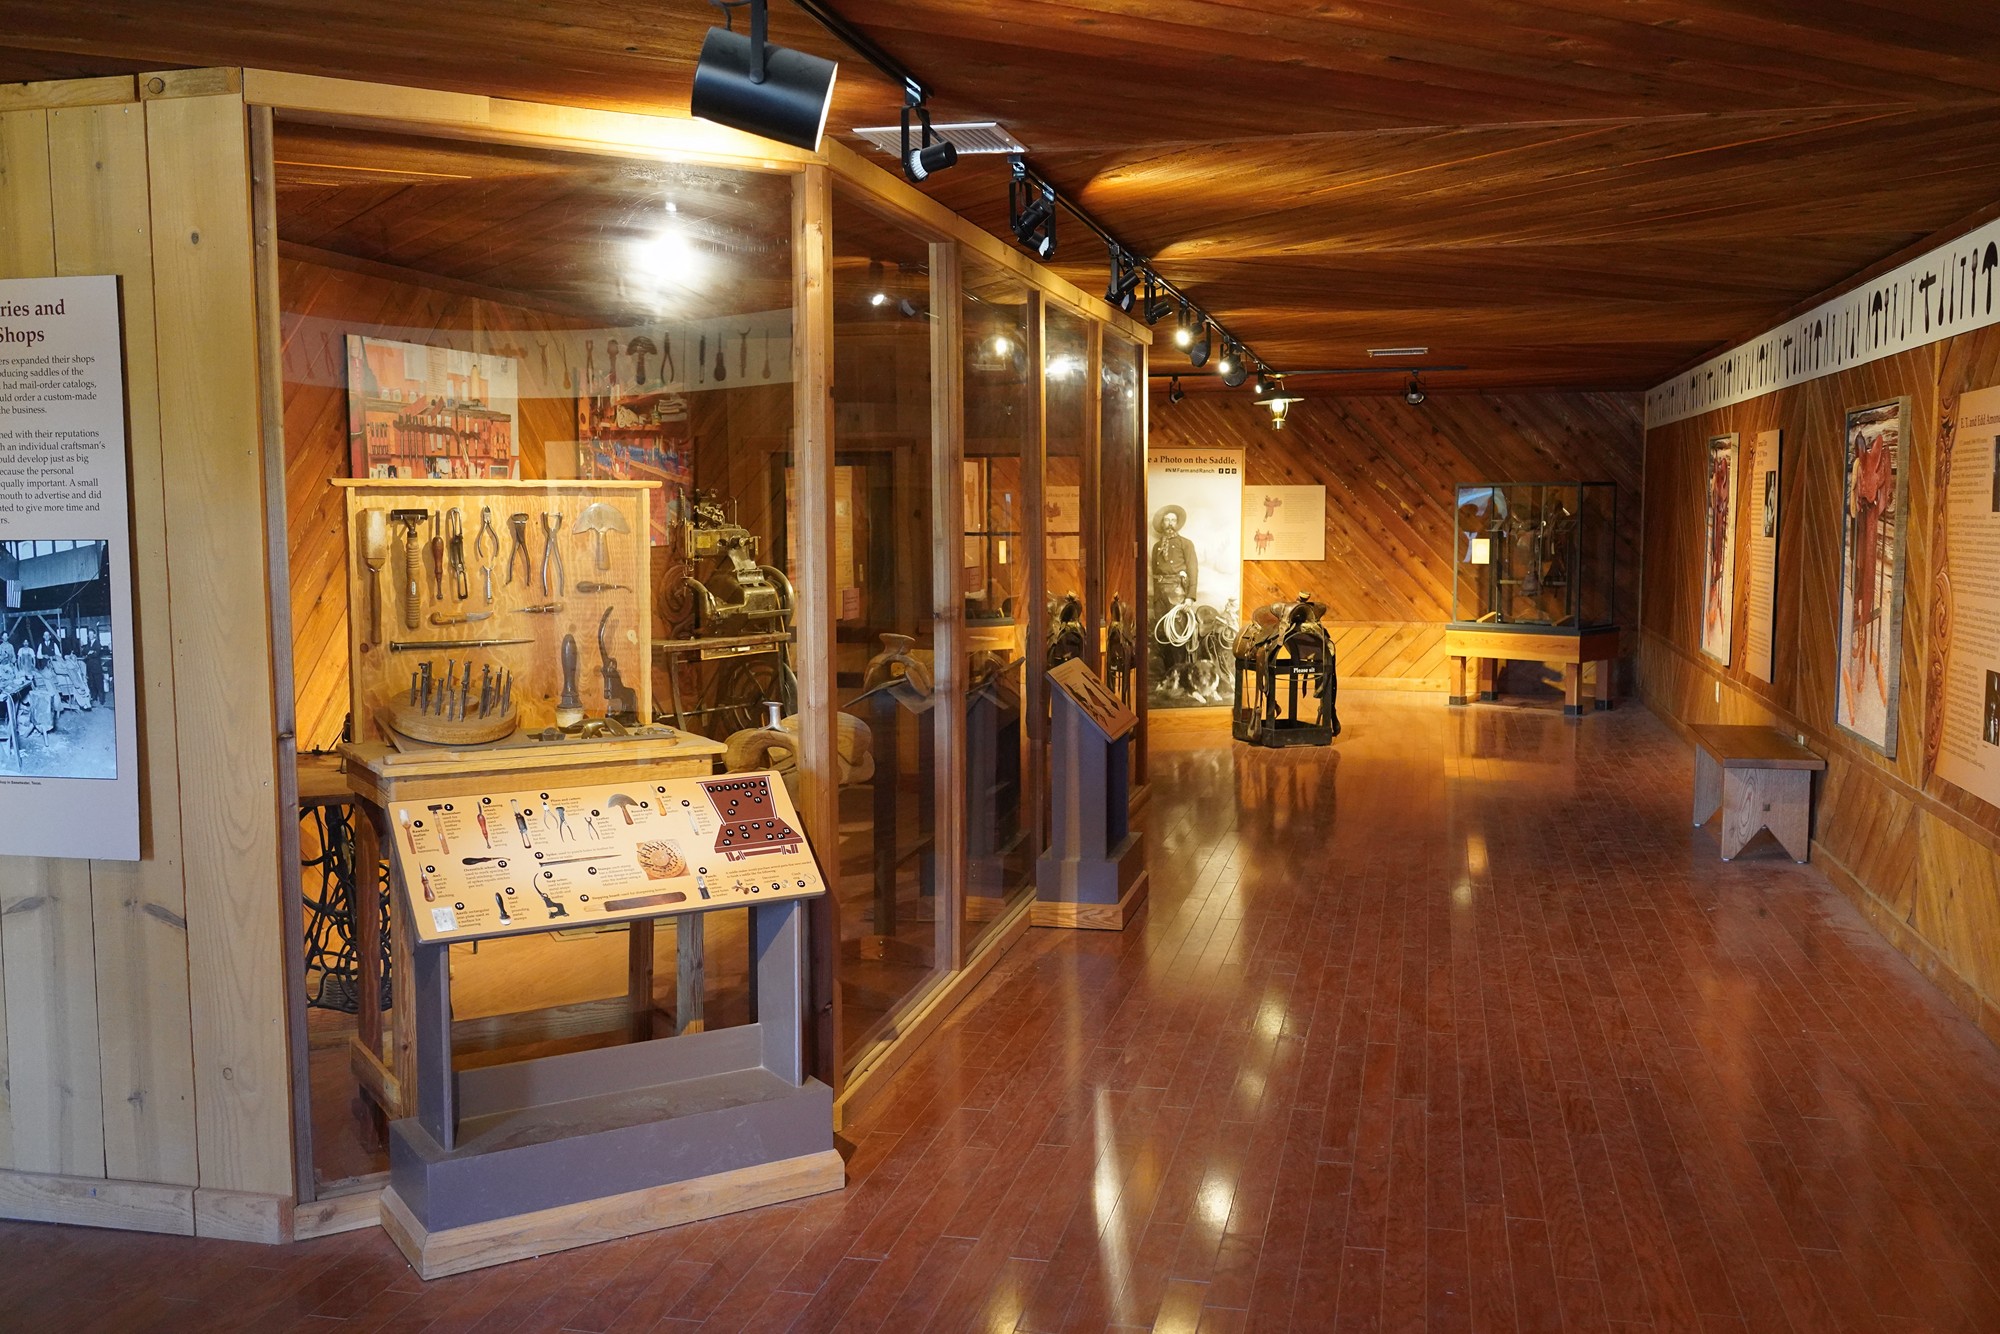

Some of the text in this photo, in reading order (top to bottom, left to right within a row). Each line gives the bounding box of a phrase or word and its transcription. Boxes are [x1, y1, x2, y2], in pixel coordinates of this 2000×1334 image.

[0, 299, 66, 316] ries and
[12, 356, 49, 367] expanded
[52, 355, 70, 364] their
[72, 355, 95, 365] shops
[0, 370, 28, 379] ducing
[30, 368, 60, 377] saddles
[72, 367, 84, 375] the
[3, 380, 97, 390] had mail-order catalogs,
[44, 392, 97, 401] custom-made
[12, 405, 47, 414] business.
[15, 430, 32, 438] with
[55, 429, 100, 440] reputations
[19, 442, 59, 450] individual
[18, 454, 48, 465] develop
[50, 455, 64, 464] just
[76, 454, 89, 464] big
[27, 467, 38, 475] the
[41, 466, 74, 477] personal
[27, 479, 67, 489] important.
[78, 478, 98, 486] small
[34, 491, 70, 499] advertise
[72, 491, 86, 499] and
[88, 490, 102, 499] did
[0, 504, 14, 512] ted
[26, 504, 42, 514] give
[85, 503, 100, 511] and
